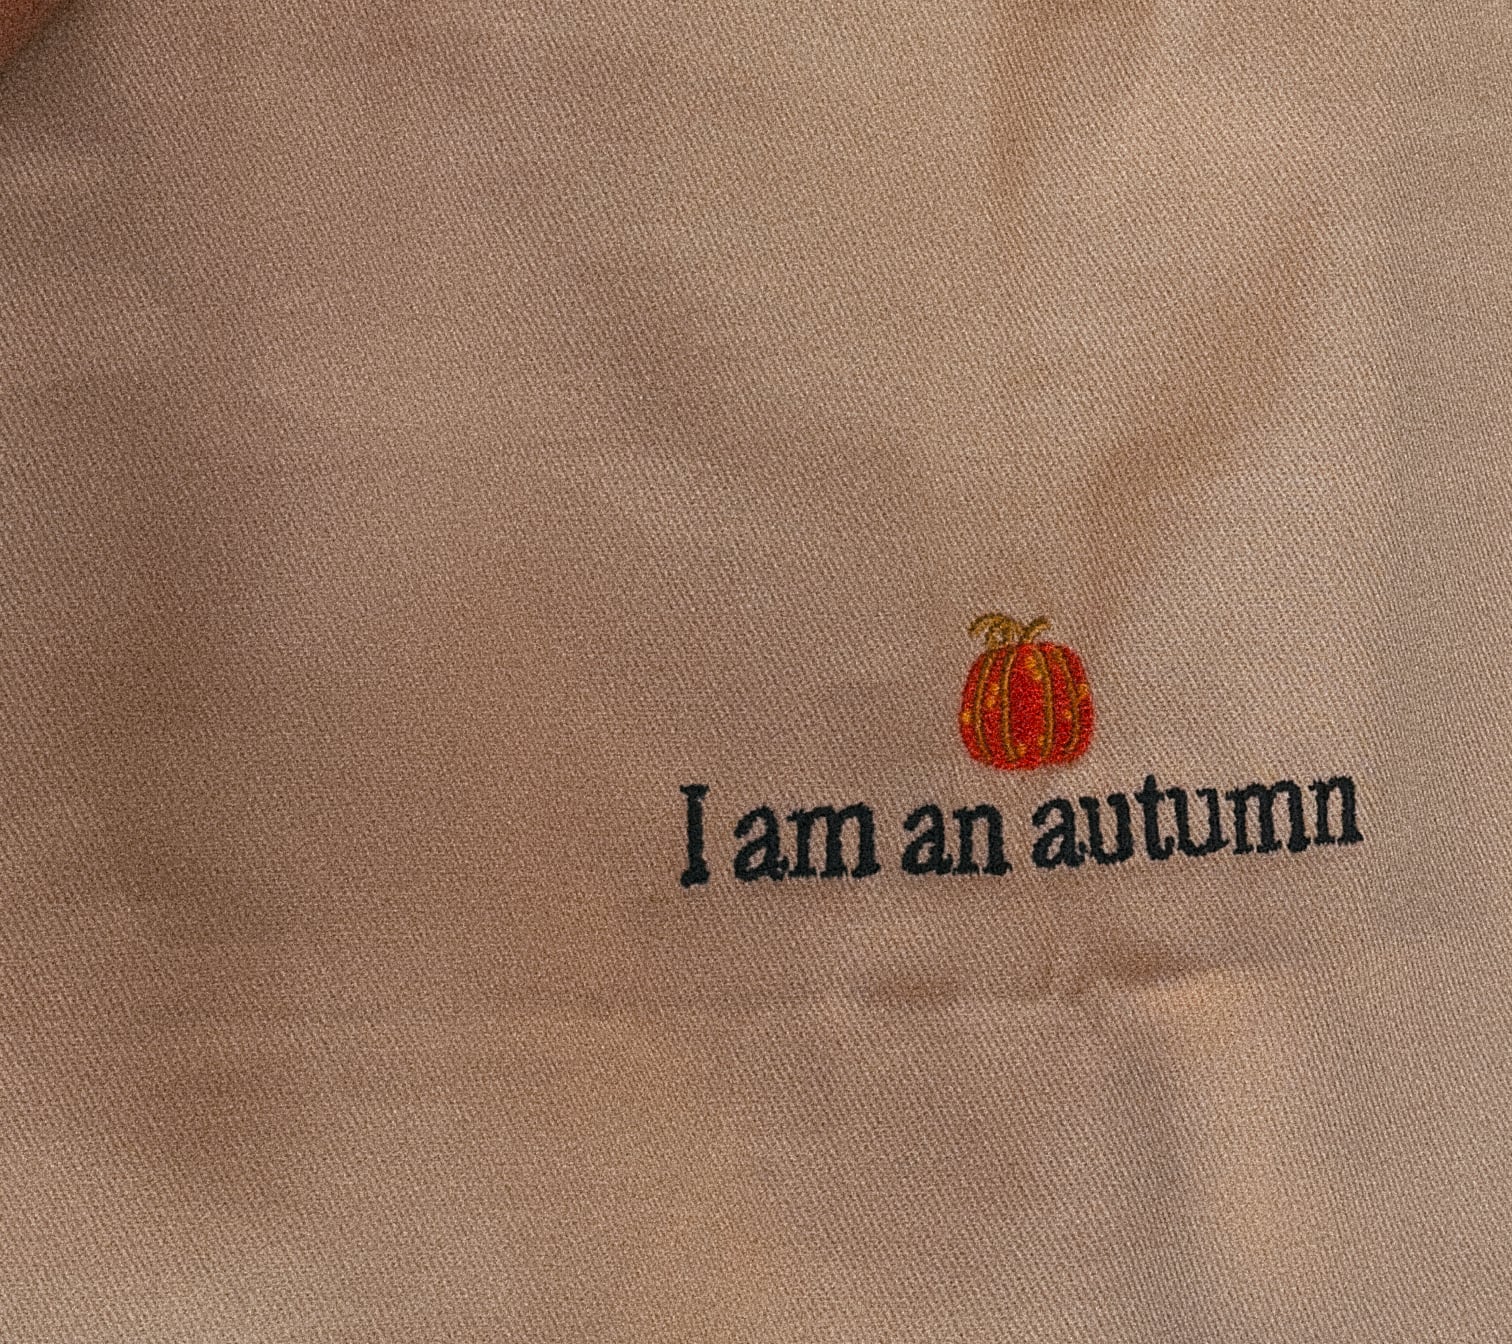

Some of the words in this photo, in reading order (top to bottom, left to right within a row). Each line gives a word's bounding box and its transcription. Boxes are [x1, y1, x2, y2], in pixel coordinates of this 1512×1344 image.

[678, 783, 711, 889] I
[732, 802, 882, 884] am
[900, 803, 1013, 880] an
[1031, 774, 1363, 870] autumn
